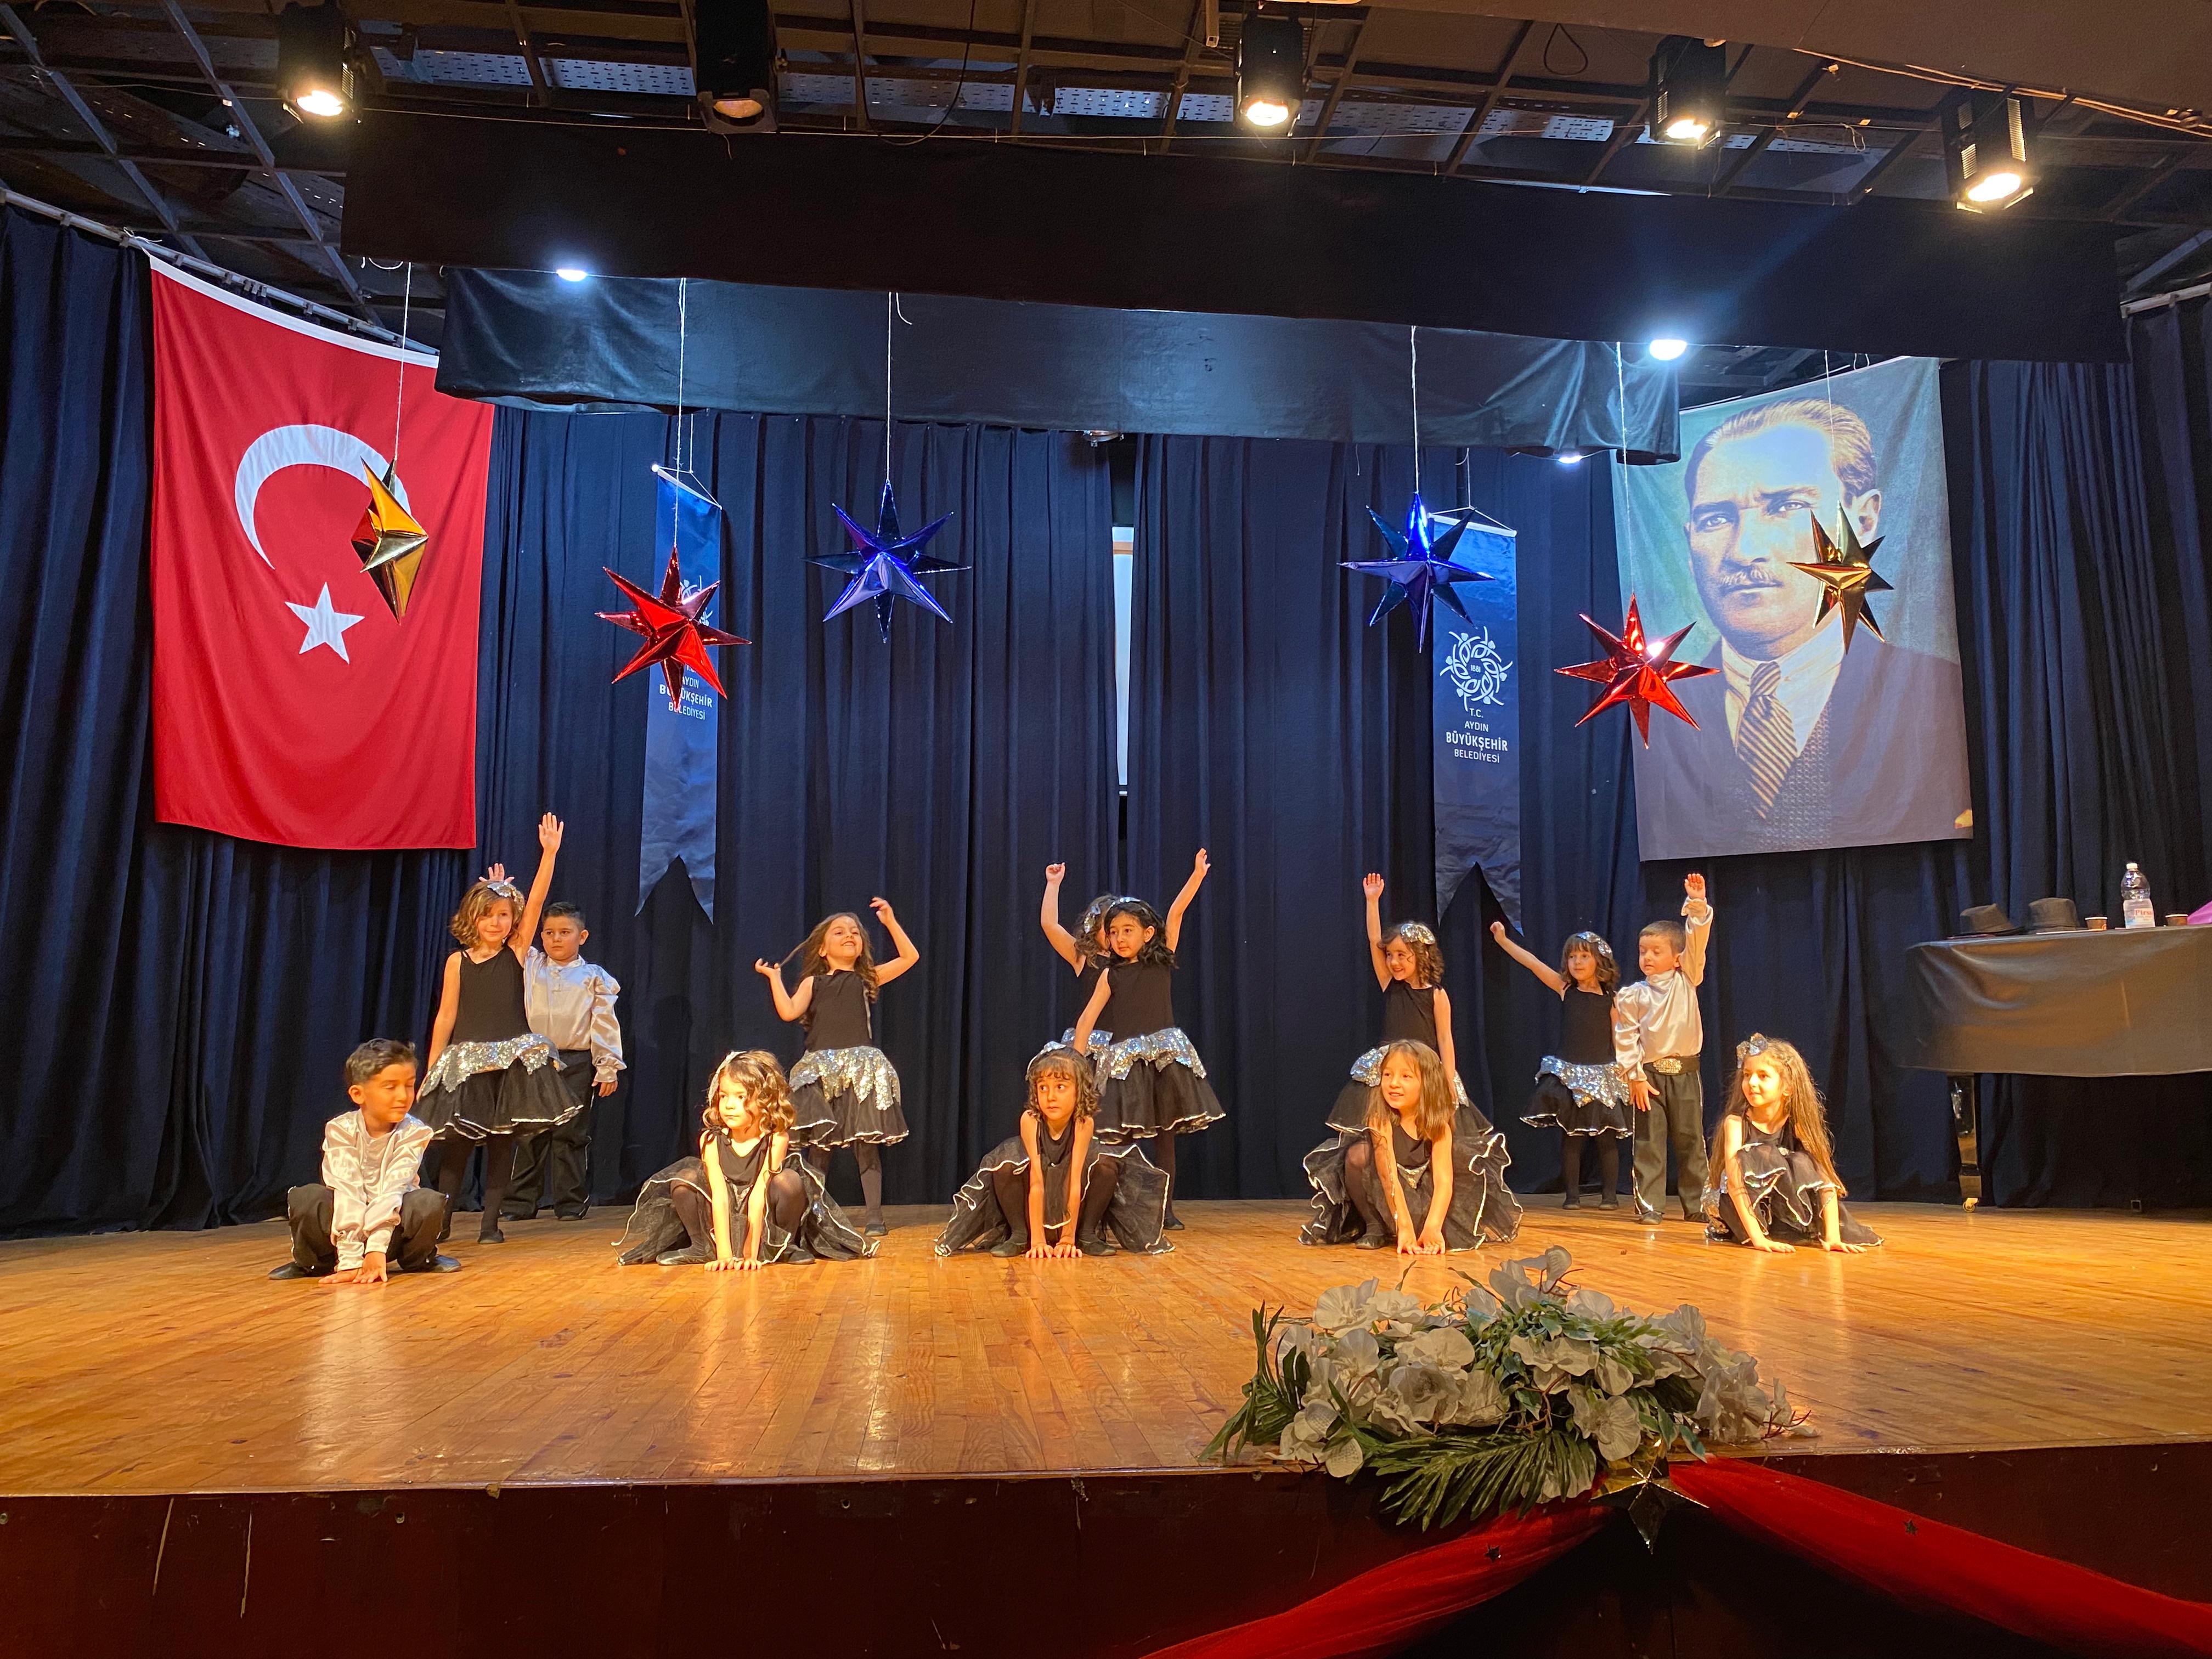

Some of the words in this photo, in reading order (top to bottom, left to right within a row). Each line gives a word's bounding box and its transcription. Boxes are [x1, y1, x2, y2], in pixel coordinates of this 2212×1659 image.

[1470, 664, 1481, 673] 1881
[659, 684, 713, 708] BÜKŞEHİR
[1469, 708, 1483, 718] T.C.
[1464, 720, 1489, 732] AYDIN
[1446, 730, 1508, 752] BÜYÜKŞEHİR
[1454, 748, 1500, 763] BELEDİYESİ
